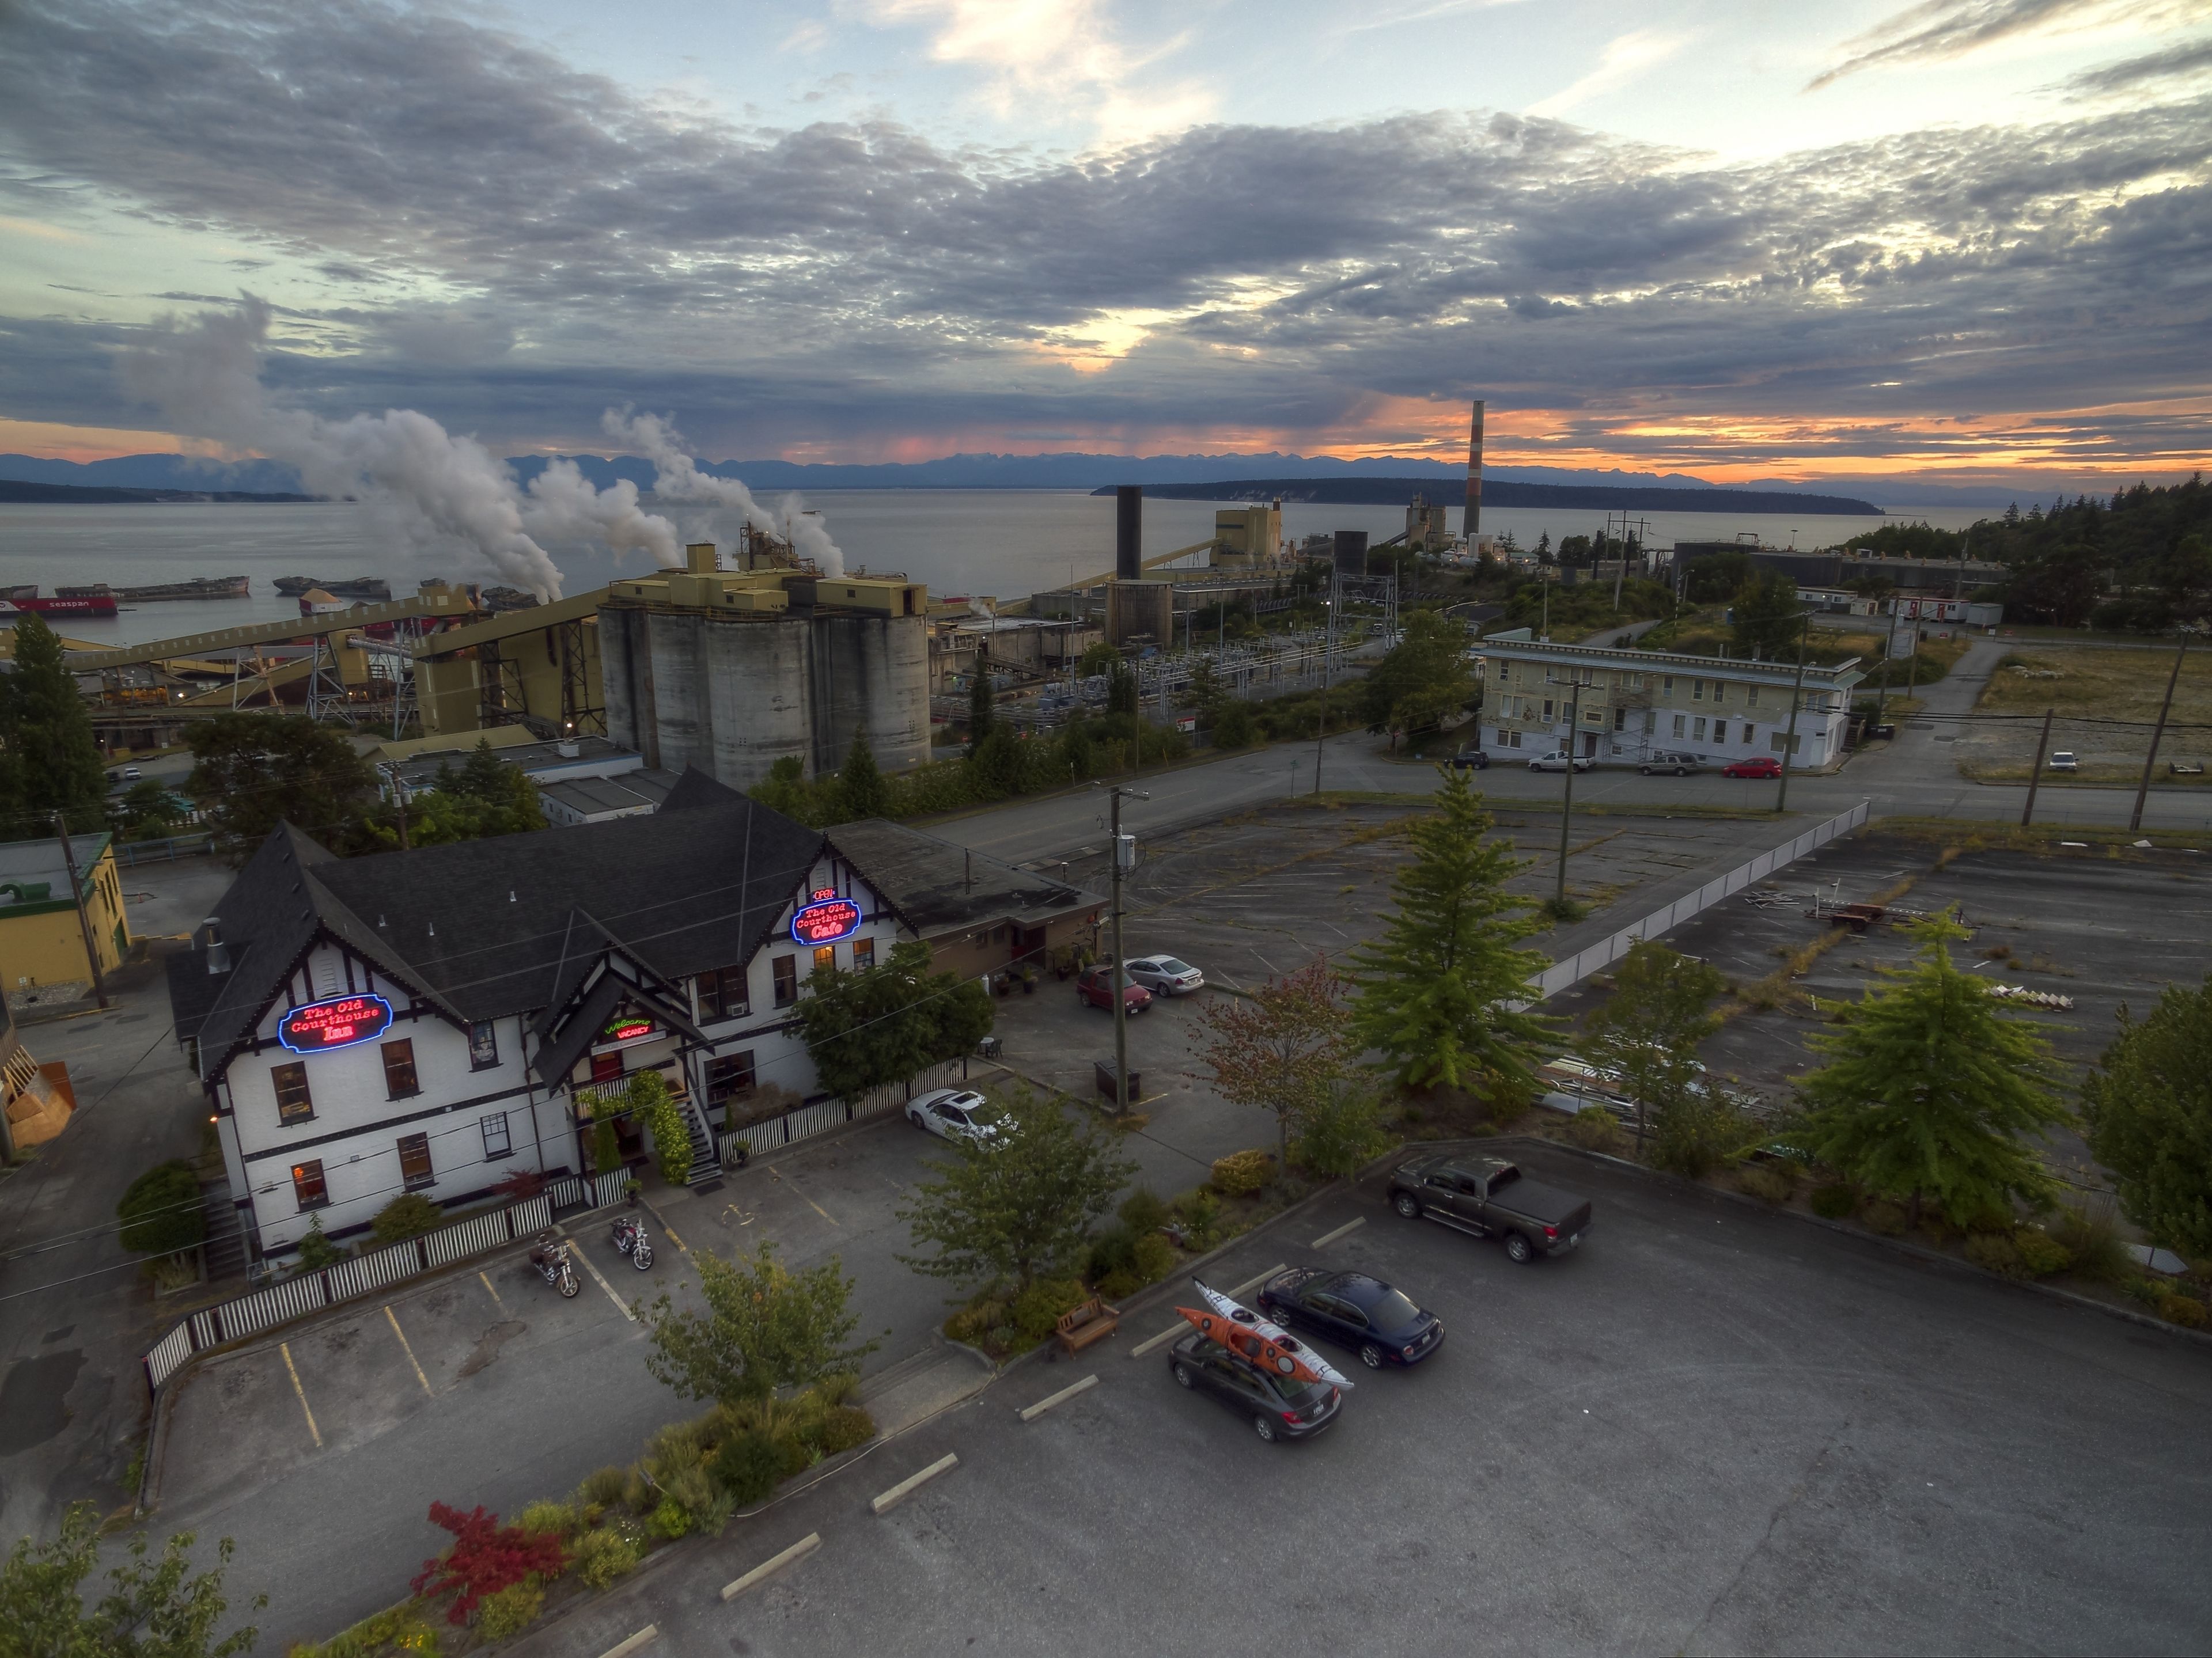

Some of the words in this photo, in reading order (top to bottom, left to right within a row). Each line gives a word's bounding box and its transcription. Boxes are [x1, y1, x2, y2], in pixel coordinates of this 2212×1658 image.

[815, 889, 833, 900] OPEN
[806, 909, 825, 918] The
[828, 903, 846, 913] Old
[797, 911, 855, 928] Courthouse
[811, 922, 843, 938] Cafe
[304, 1007, 332, 1020] The
[338, 1000, 364, 1012] Old
[291, 1009, 379, 1032] Courthouse
[605, 1019, 650, 1034] Welcome
[324, 1026, 353, 1041] Inn
[617, 1026, 649, 1038] VACANCY
